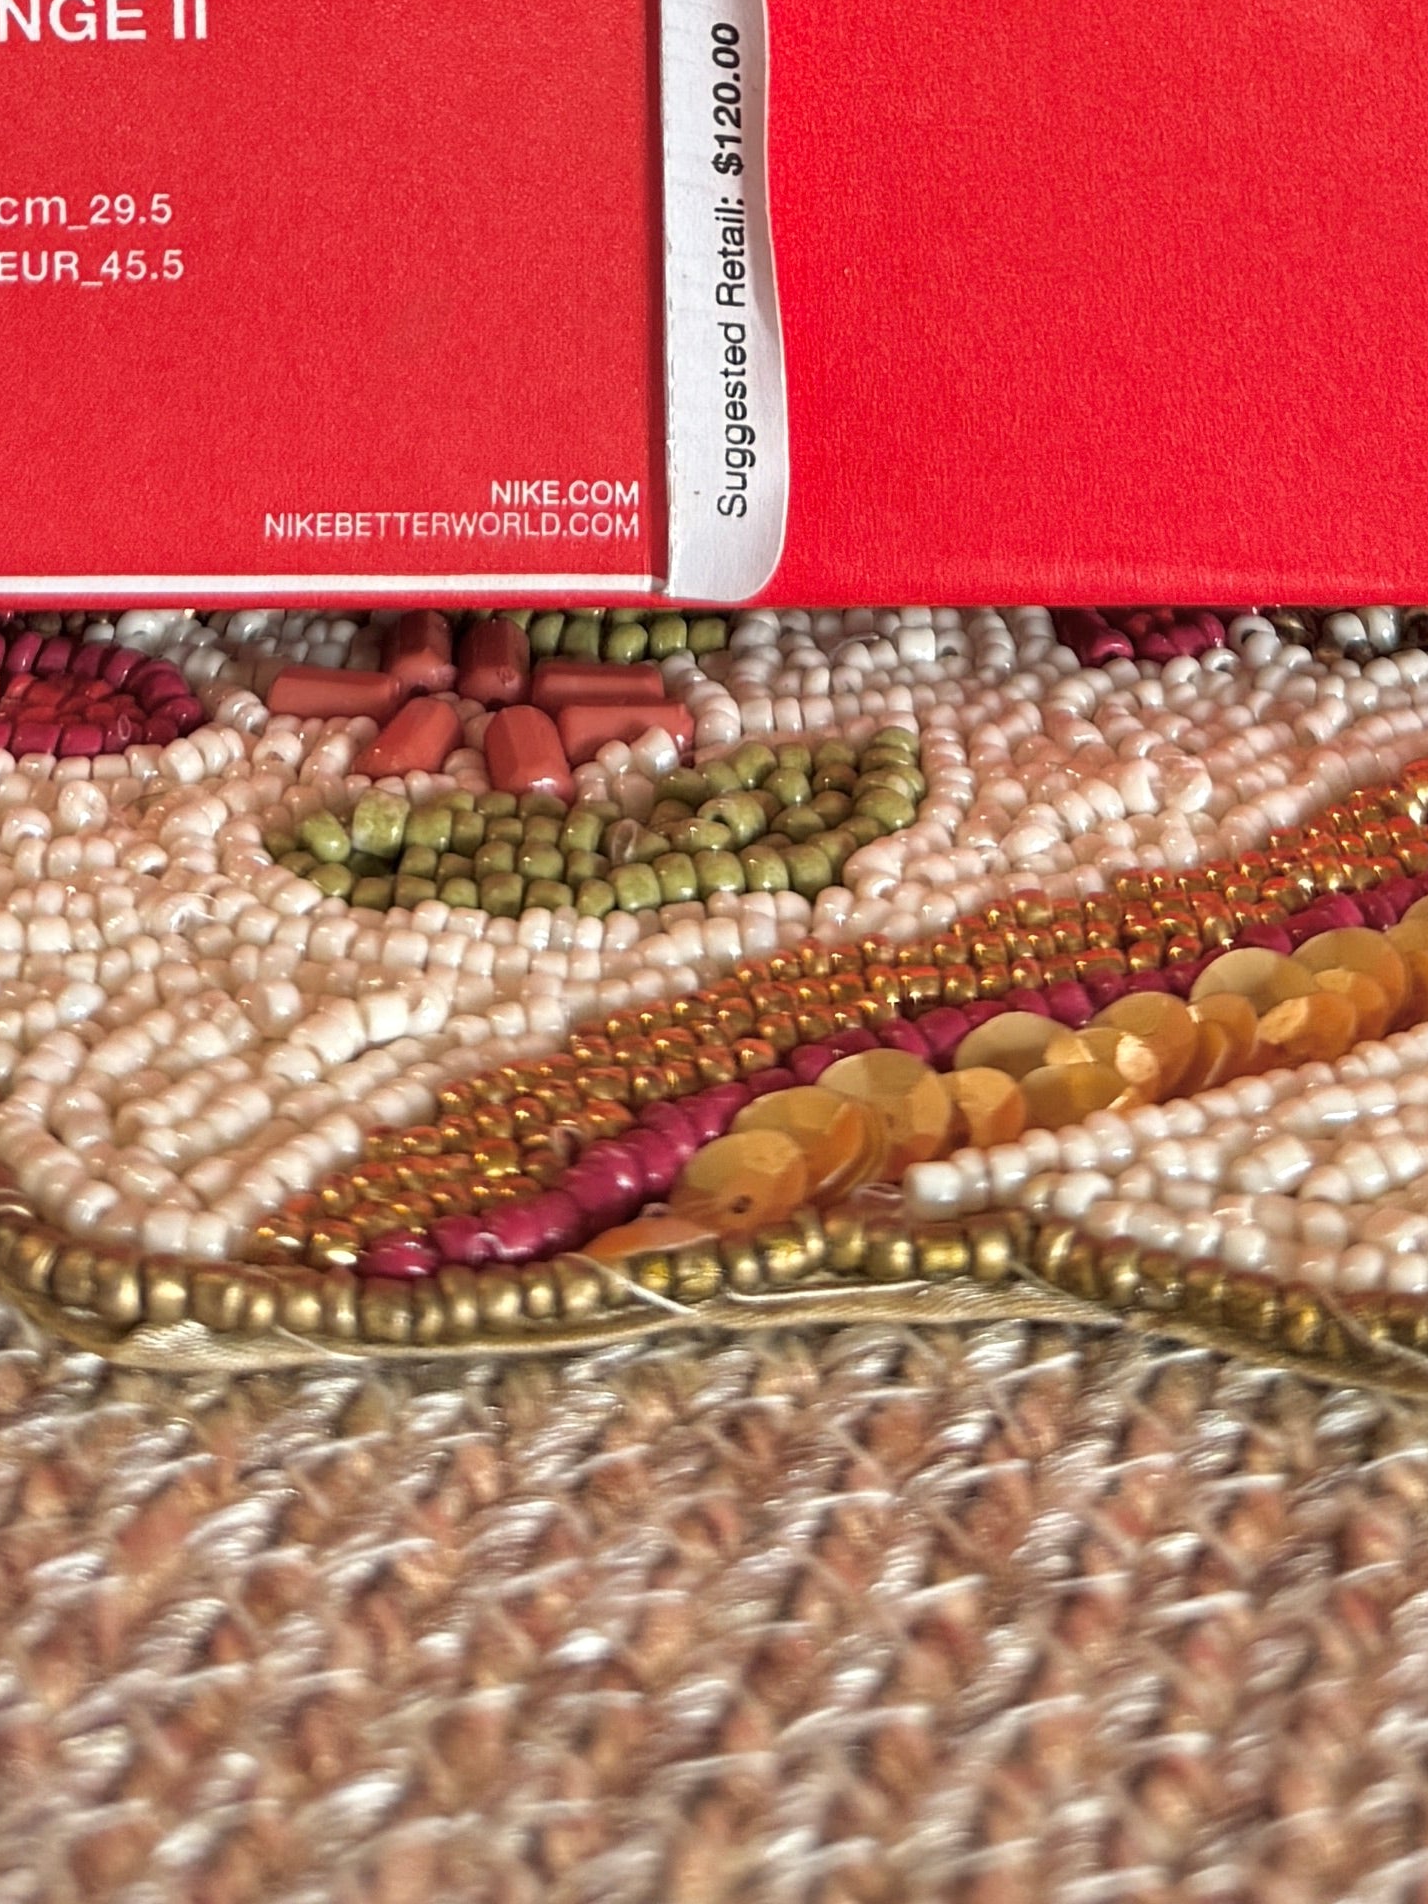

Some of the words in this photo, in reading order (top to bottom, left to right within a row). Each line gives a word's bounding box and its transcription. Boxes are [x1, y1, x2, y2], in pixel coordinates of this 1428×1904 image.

[710, 22, 745, 177] $120.00
[713, 196, 746, 307] Retail:
[716, 322, 756, 518] Suggested
[264, 511, 640, 539] NIKEBETTERWORLD.COM
[491, 479, 640, 507] NIKE.COM
